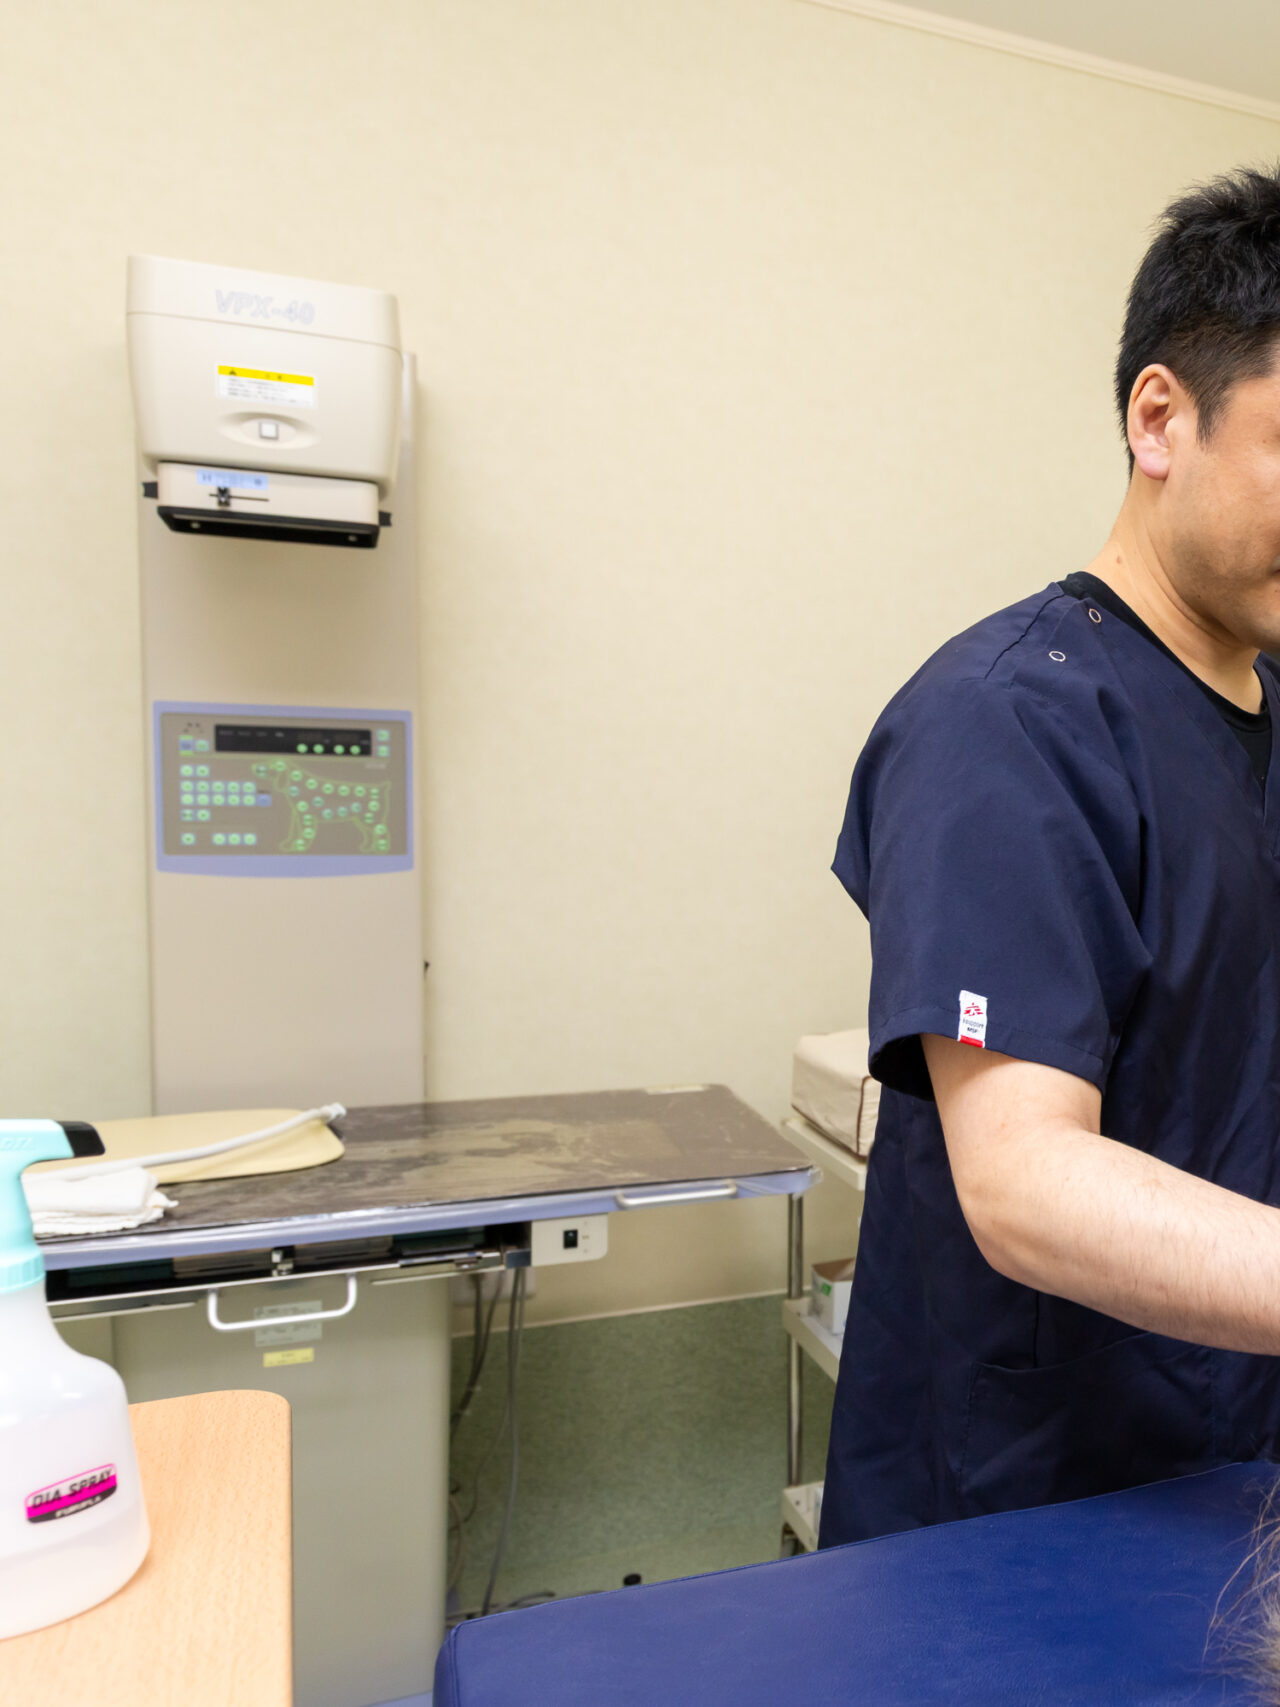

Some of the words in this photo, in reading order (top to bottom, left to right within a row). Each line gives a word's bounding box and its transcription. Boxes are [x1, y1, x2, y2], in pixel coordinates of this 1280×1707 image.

[215, 289, 315, 325] VPX-40
[32, 1488, 62, 1509] DIA
[68, 1468, 112, 1497] SPRAY
